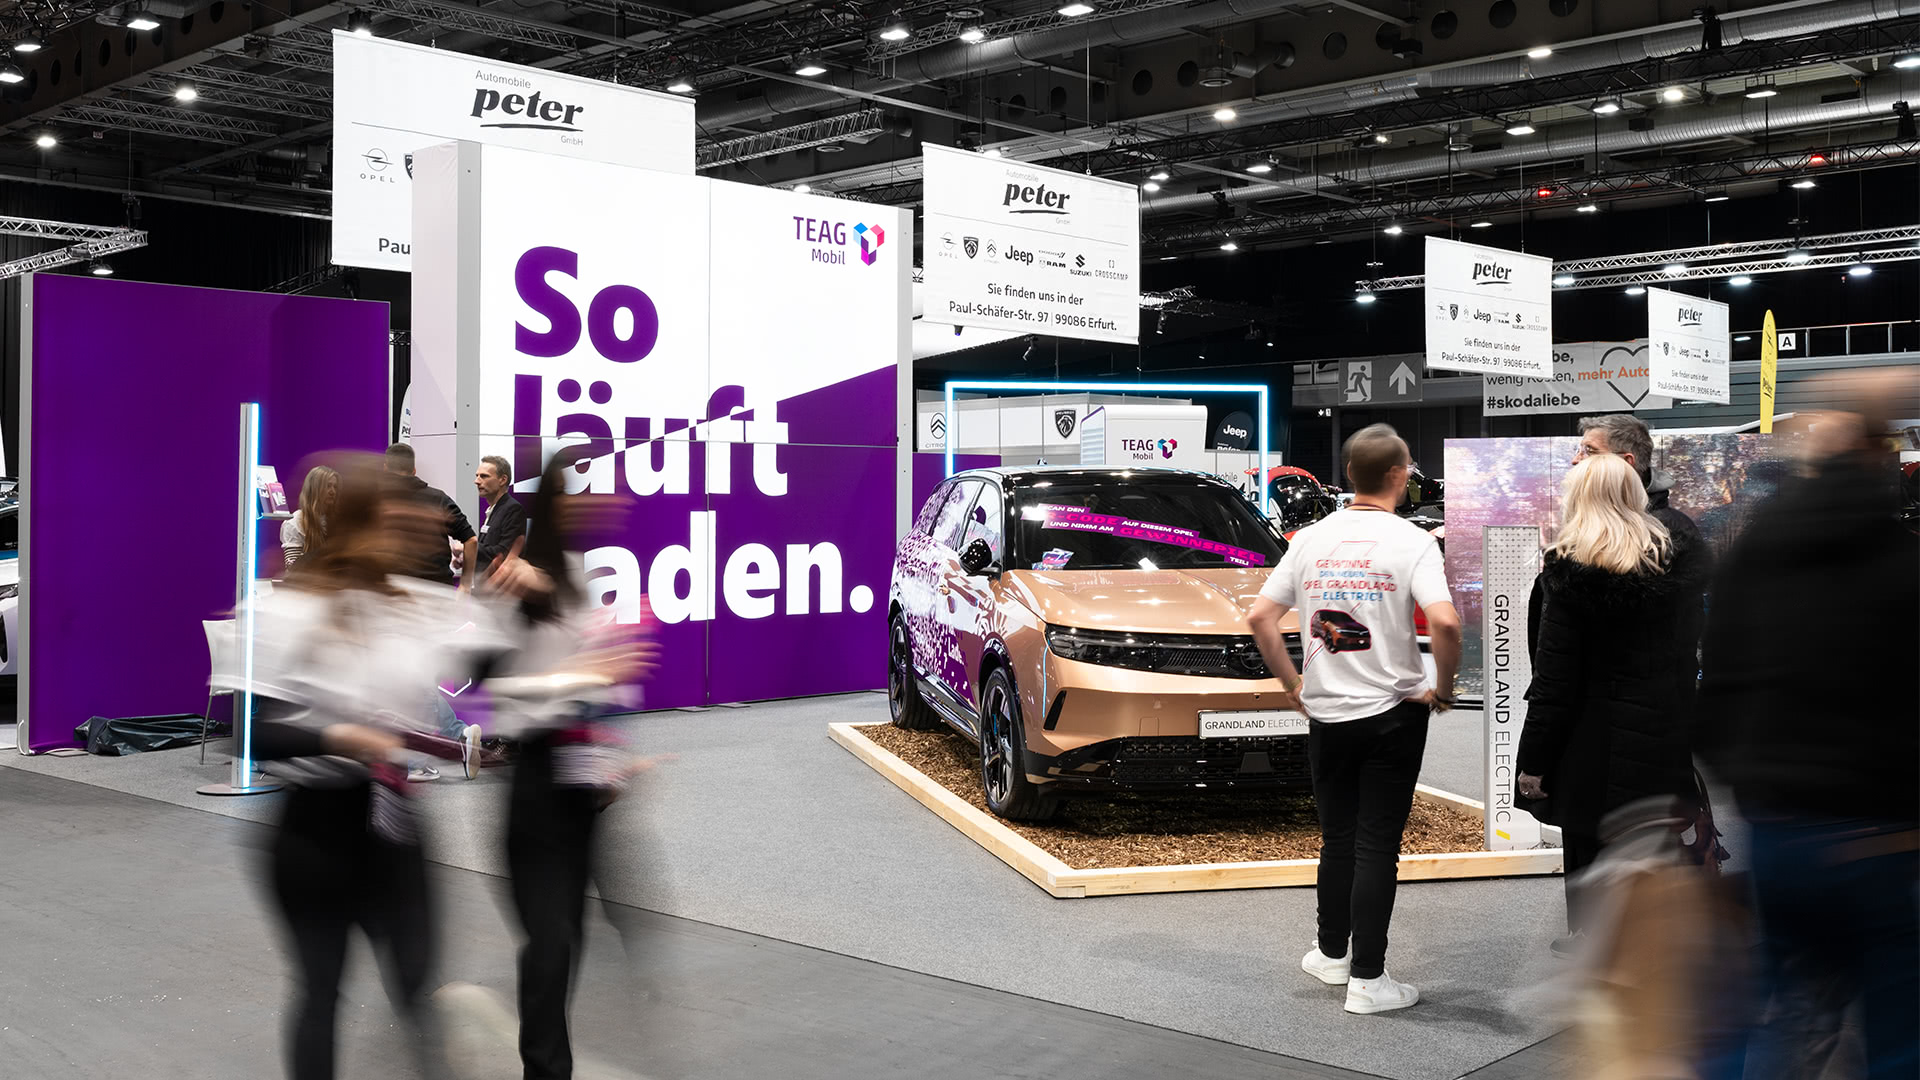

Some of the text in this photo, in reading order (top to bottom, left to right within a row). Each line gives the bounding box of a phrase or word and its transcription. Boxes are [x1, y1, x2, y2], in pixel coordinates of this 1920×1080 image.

[475, 70, 531, 89] Automobile
[470, 88, 584, 125] peter
[560, 135, 584, 146] GmbH
[360, 173, 395, 184] OPEL
[1002, 183, 1070, 209] peter
[793, 216, 846, 246] TEAG
[811, 248, 845, 266] Mobil
[1005, 245, 1034, 266] Jeep
[1069, 269, 1092, 277] SUZUKI
[1472, 261, 1512, 280] peter
[987, 282, 1084, 306] Sie finden uns in der
[515, 246, 659, 364] So
[949, 300, 1117, 331] Paul-Schäfer-Str. 97 99086 Erfurt.
[1473, 309, 1492, 324] Jeep
[1678, 307, 1702, 322] peter
[1464, 337, 1521, 352] Sie finden uns in der
[1783, 336, 1792, 347] A
[1578, 367, 1614, 381] mehr
[1486, 393, 1581, 409] #skodaliebe
[513, 373, 789, 497] läuft
[1223, 424, 1247, 439] Jeep
[1122, 439, 1154, 451] TEAG
[1133, 452, 1154, 461] Mobil
[1071, 522, 1098, 530] NIMM
[1140, 522, 1172, 533] DIESEM
[1173, 528, 1194, 537] OPEL
[1119, 528, 1259, 562] GEWINNSPIEL
[583, 510, 875, 625] aden.
[1326, 580, 1398, 592] GRANDLAND
[1494, 593, 1511, 823] GRANDLAND ELECTRIC
[1205, 719, 1310, 730] GRANDLAND ELECTRIC
